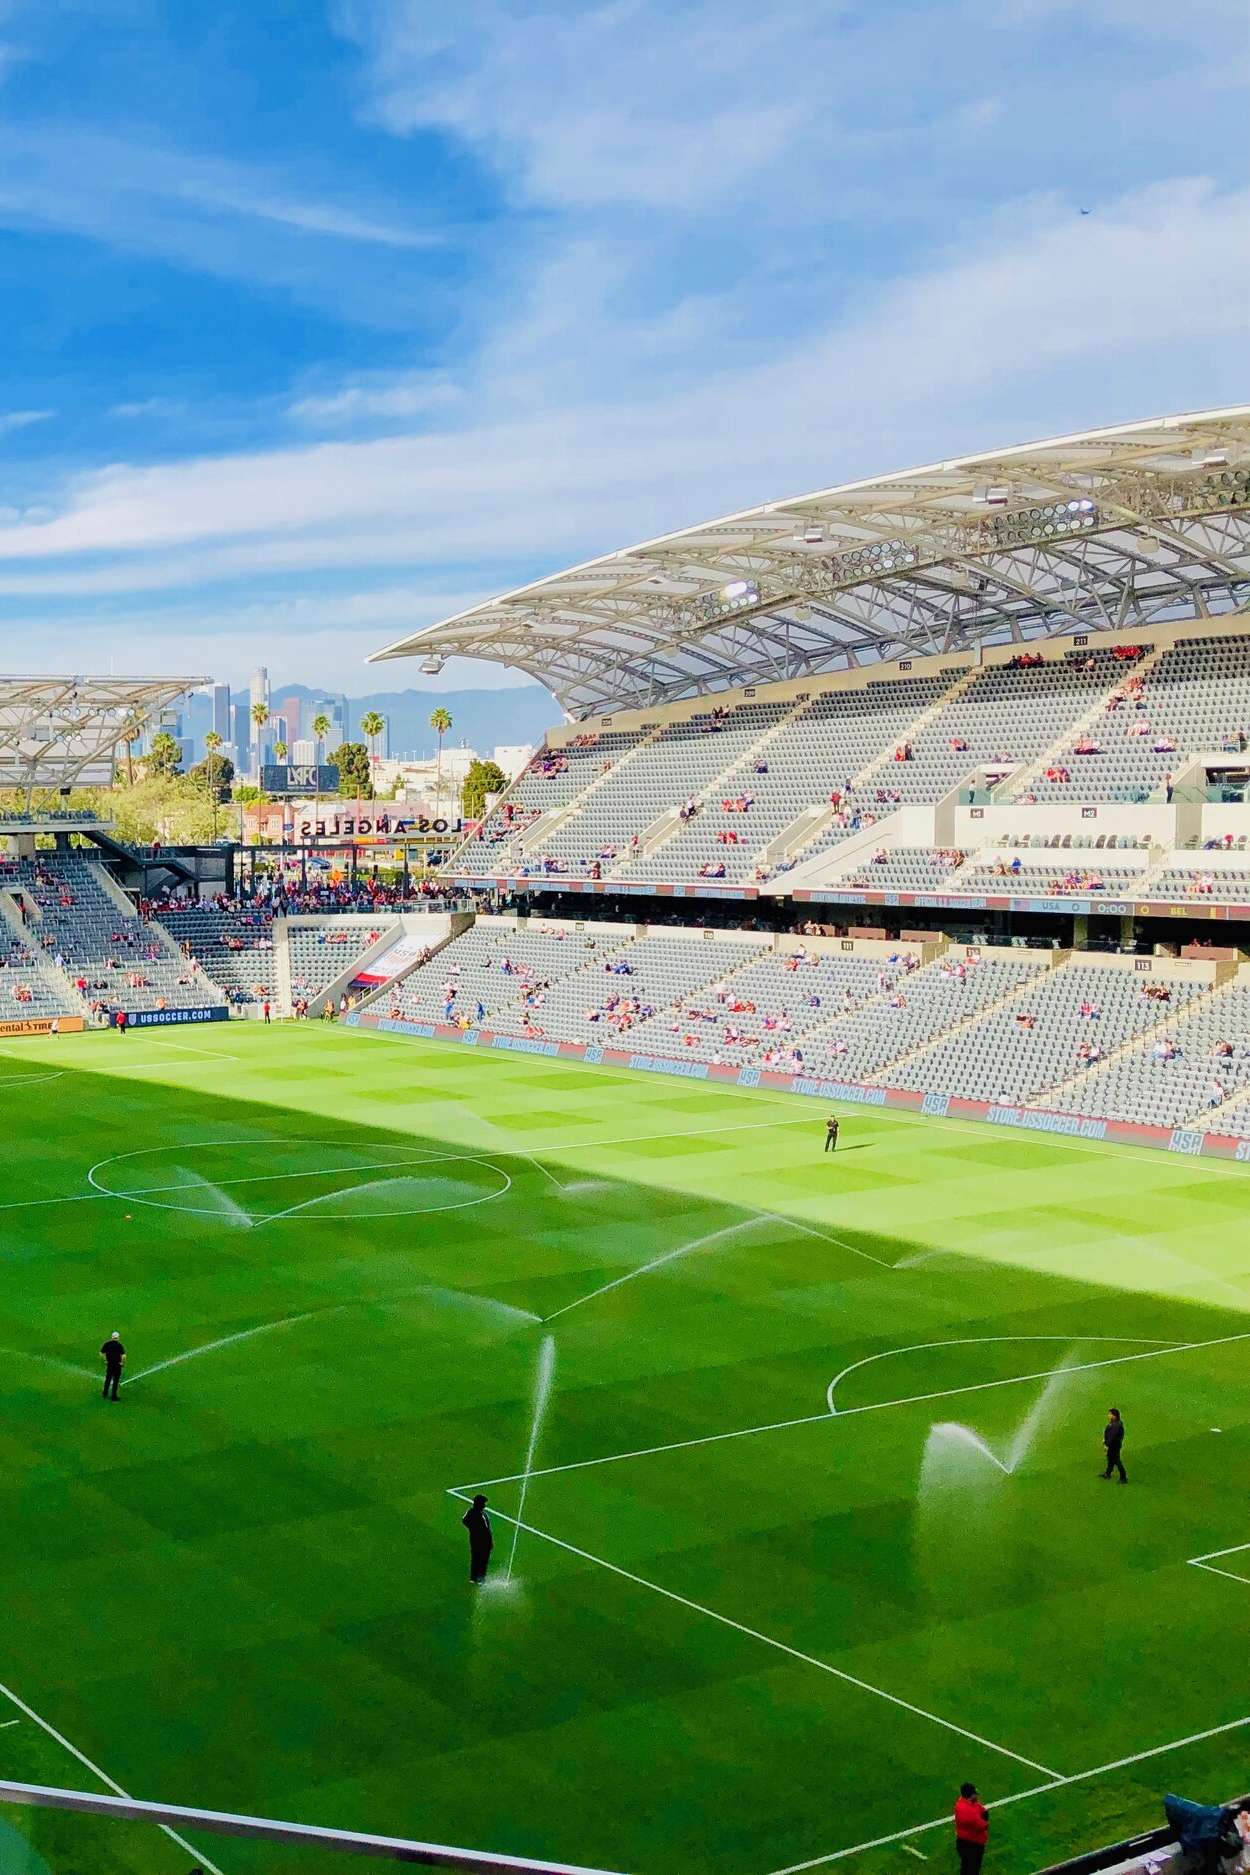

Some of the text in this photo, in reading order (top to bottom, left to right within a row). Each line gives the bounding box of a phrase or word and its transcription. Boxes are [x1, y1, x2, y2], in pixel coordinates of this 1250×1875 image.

[1042, 901, 1080, 912] USA 0
[1097, 903, 1127, 914] 0:00
[1140, 905, 1188, 917] 0 BEL
[1137, 962, 1150, 970] 113
[141, 1010, 211, 1023] USSOCCER.COM
[790, 1077, 887, 1105] STORE.USSOCCER.COM
[924, 1094, 947, 1112] USA
[986, 1105, 1107, 1140] STORE.USSOCCER.COM
[1173, 1130, 1203, 1149] USA
